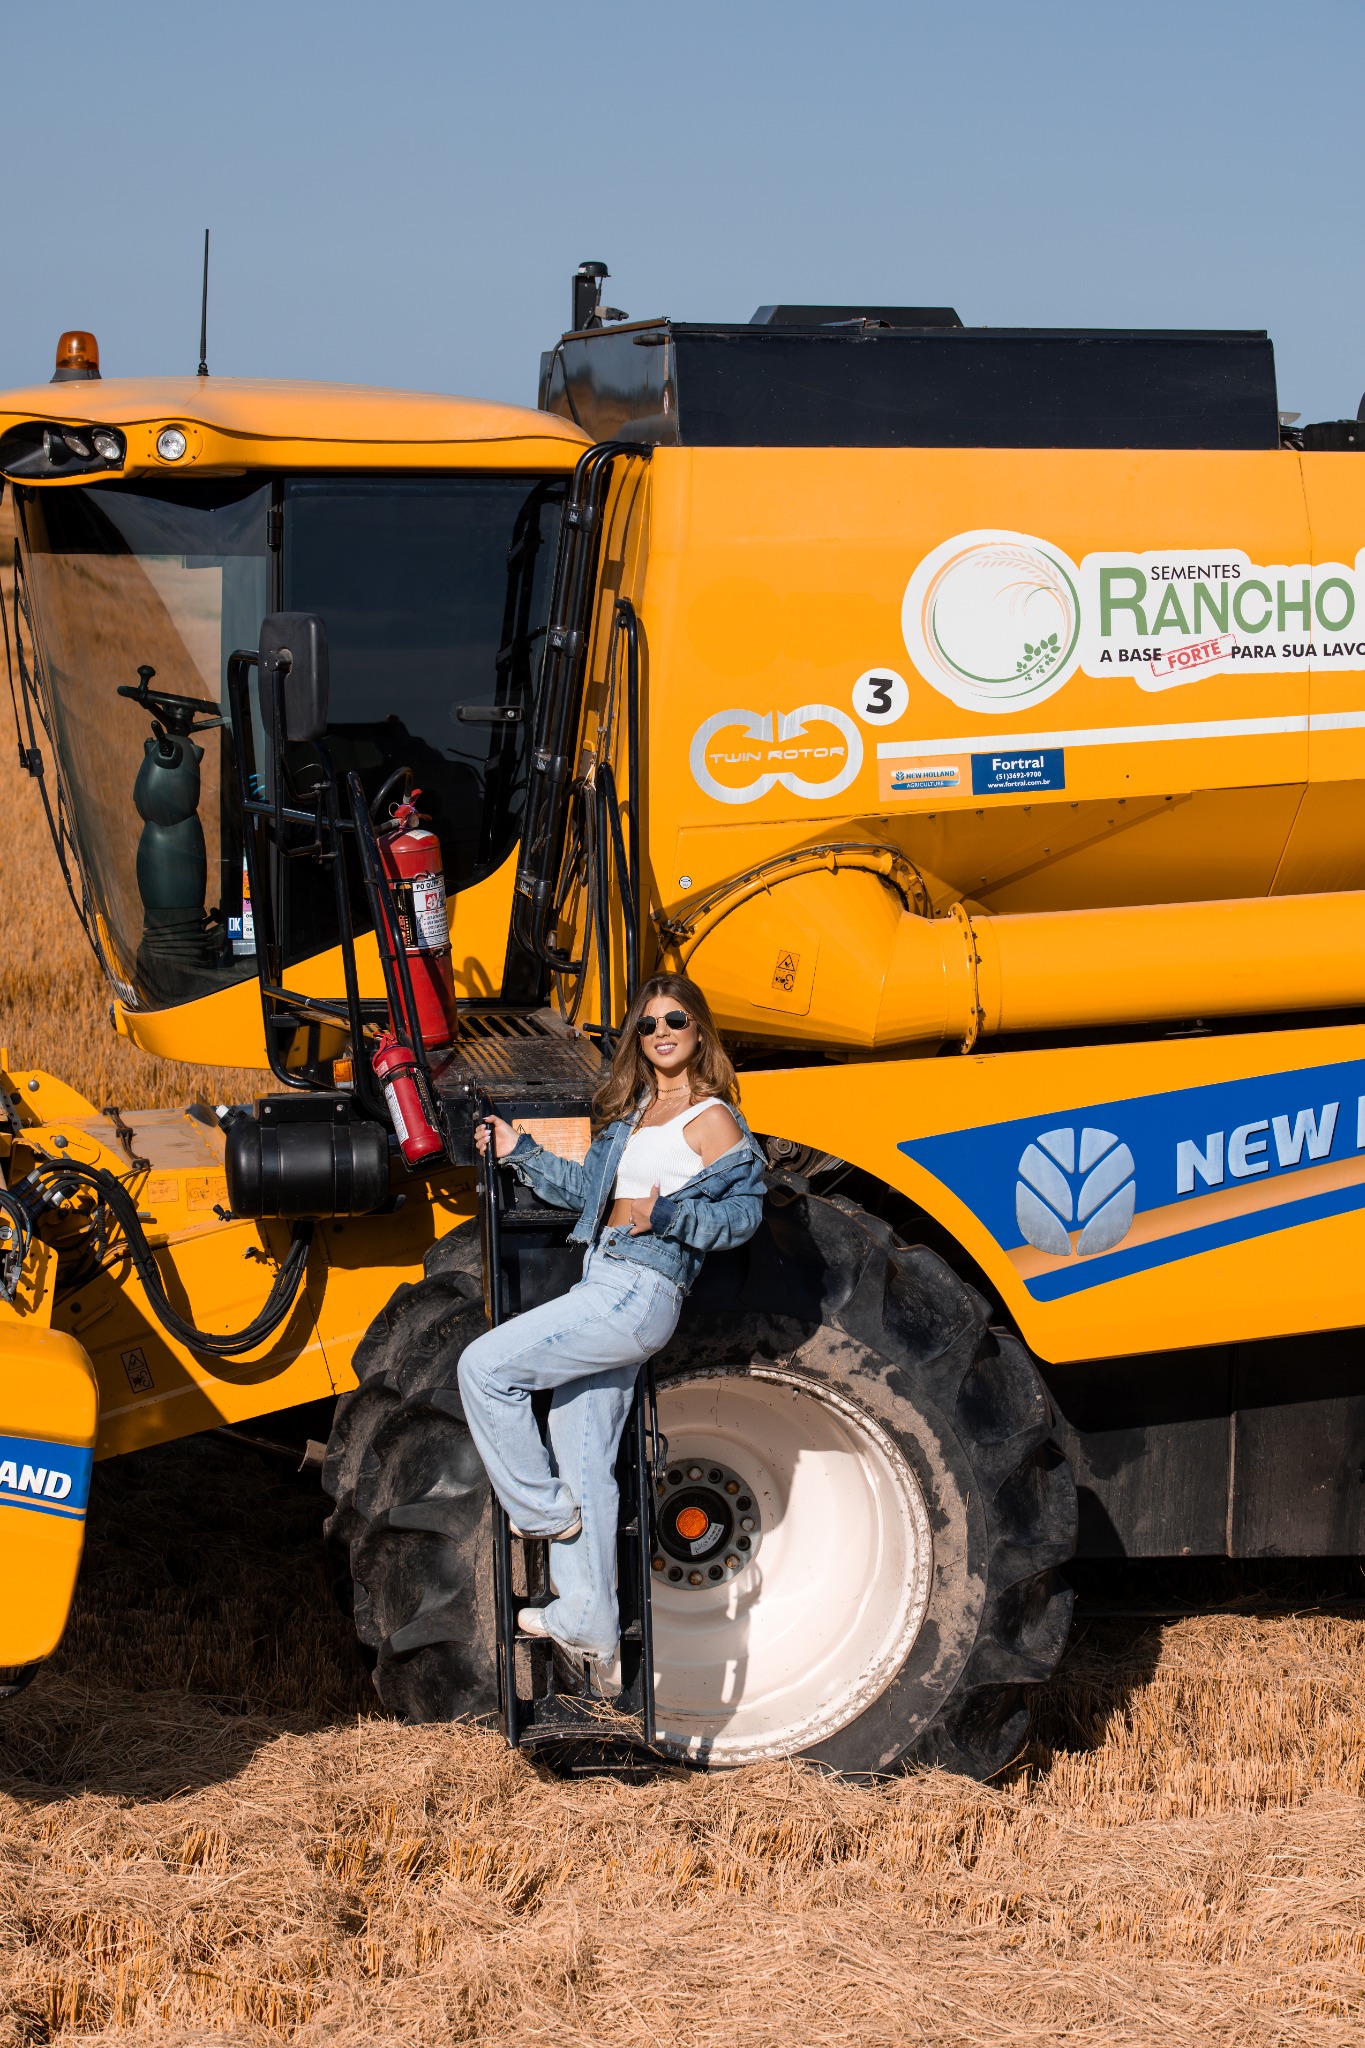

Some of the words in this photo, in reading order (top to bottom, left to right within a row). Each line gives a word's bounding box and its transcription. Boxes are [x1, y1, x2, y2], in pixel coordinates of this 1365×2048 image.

[1151, 564, 1241, 580] SEMENTES
[1100, 567, 1355, 636] RANCHO
[1100, 649, 1112, 662] A
[1119, 648, 1162, 662] BASE
[1167, 641, 1222, 669] FORTE
[1231, 644, 1277, 659] PARA
[1282, 643, 1317, 657] SUA
[865, 677, 893, 714] 3
[709, 751, 761, 764] TWIN
[767, 747, 845, 761] ROTOR
[992, 755, 1045, 771] Fortral
[923, 770, 955, 778] HOLLAND
[995, 771, 1042, 781] (51)3692-9700
[987, 779, 1050, 788] www.fortral.com.br
[229, 917, 242, 932] OK
[1177, 1101, 1340, 1195] NEW
